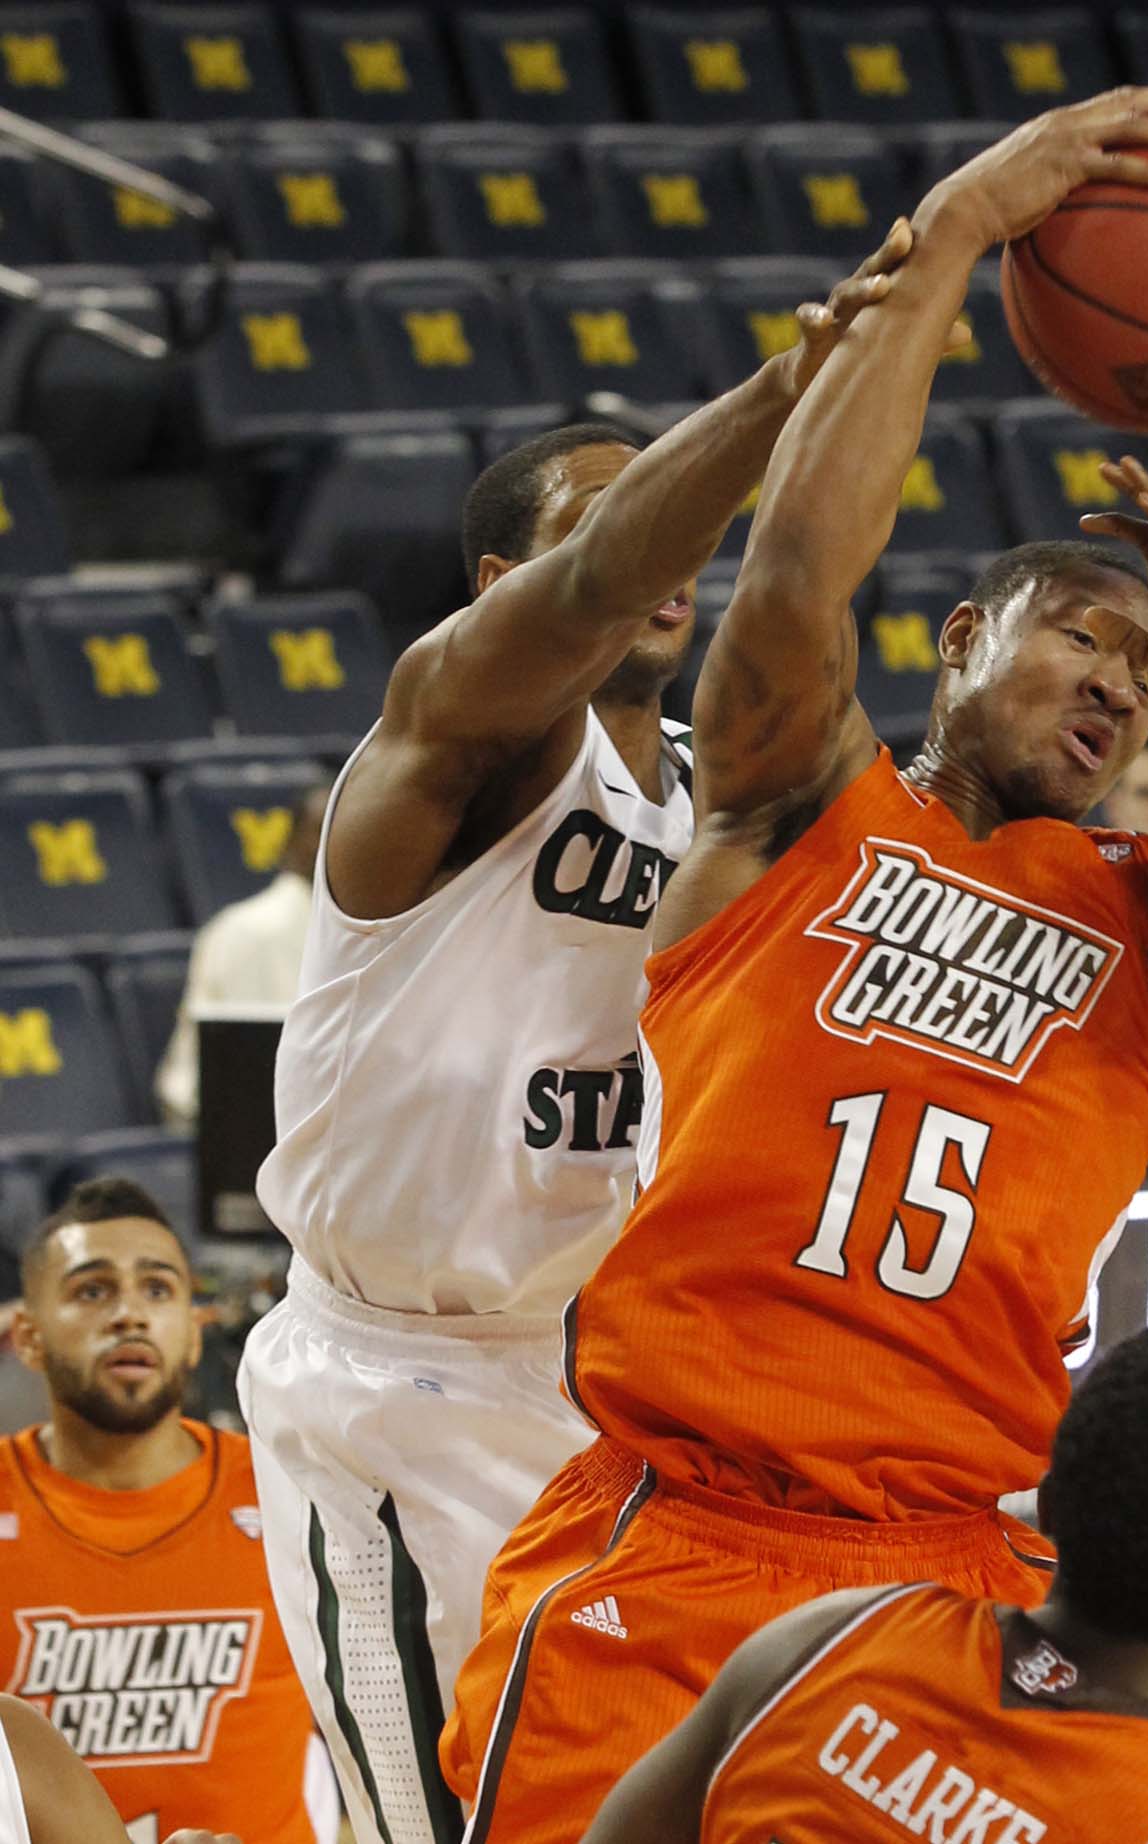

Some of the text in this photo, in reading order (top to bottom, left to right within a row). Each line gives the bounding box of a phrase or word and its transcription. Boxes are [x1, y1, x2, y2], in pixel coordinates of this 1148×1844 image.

[833, 852, 1108, 1012] BOWLING
[830, 943, 1056, 1066] GREEN
[792, 1089, 993, 1303] 15
[18, 1618, 250, 1696] BOWLING
[570, 1610, 629, 1640] adidas
